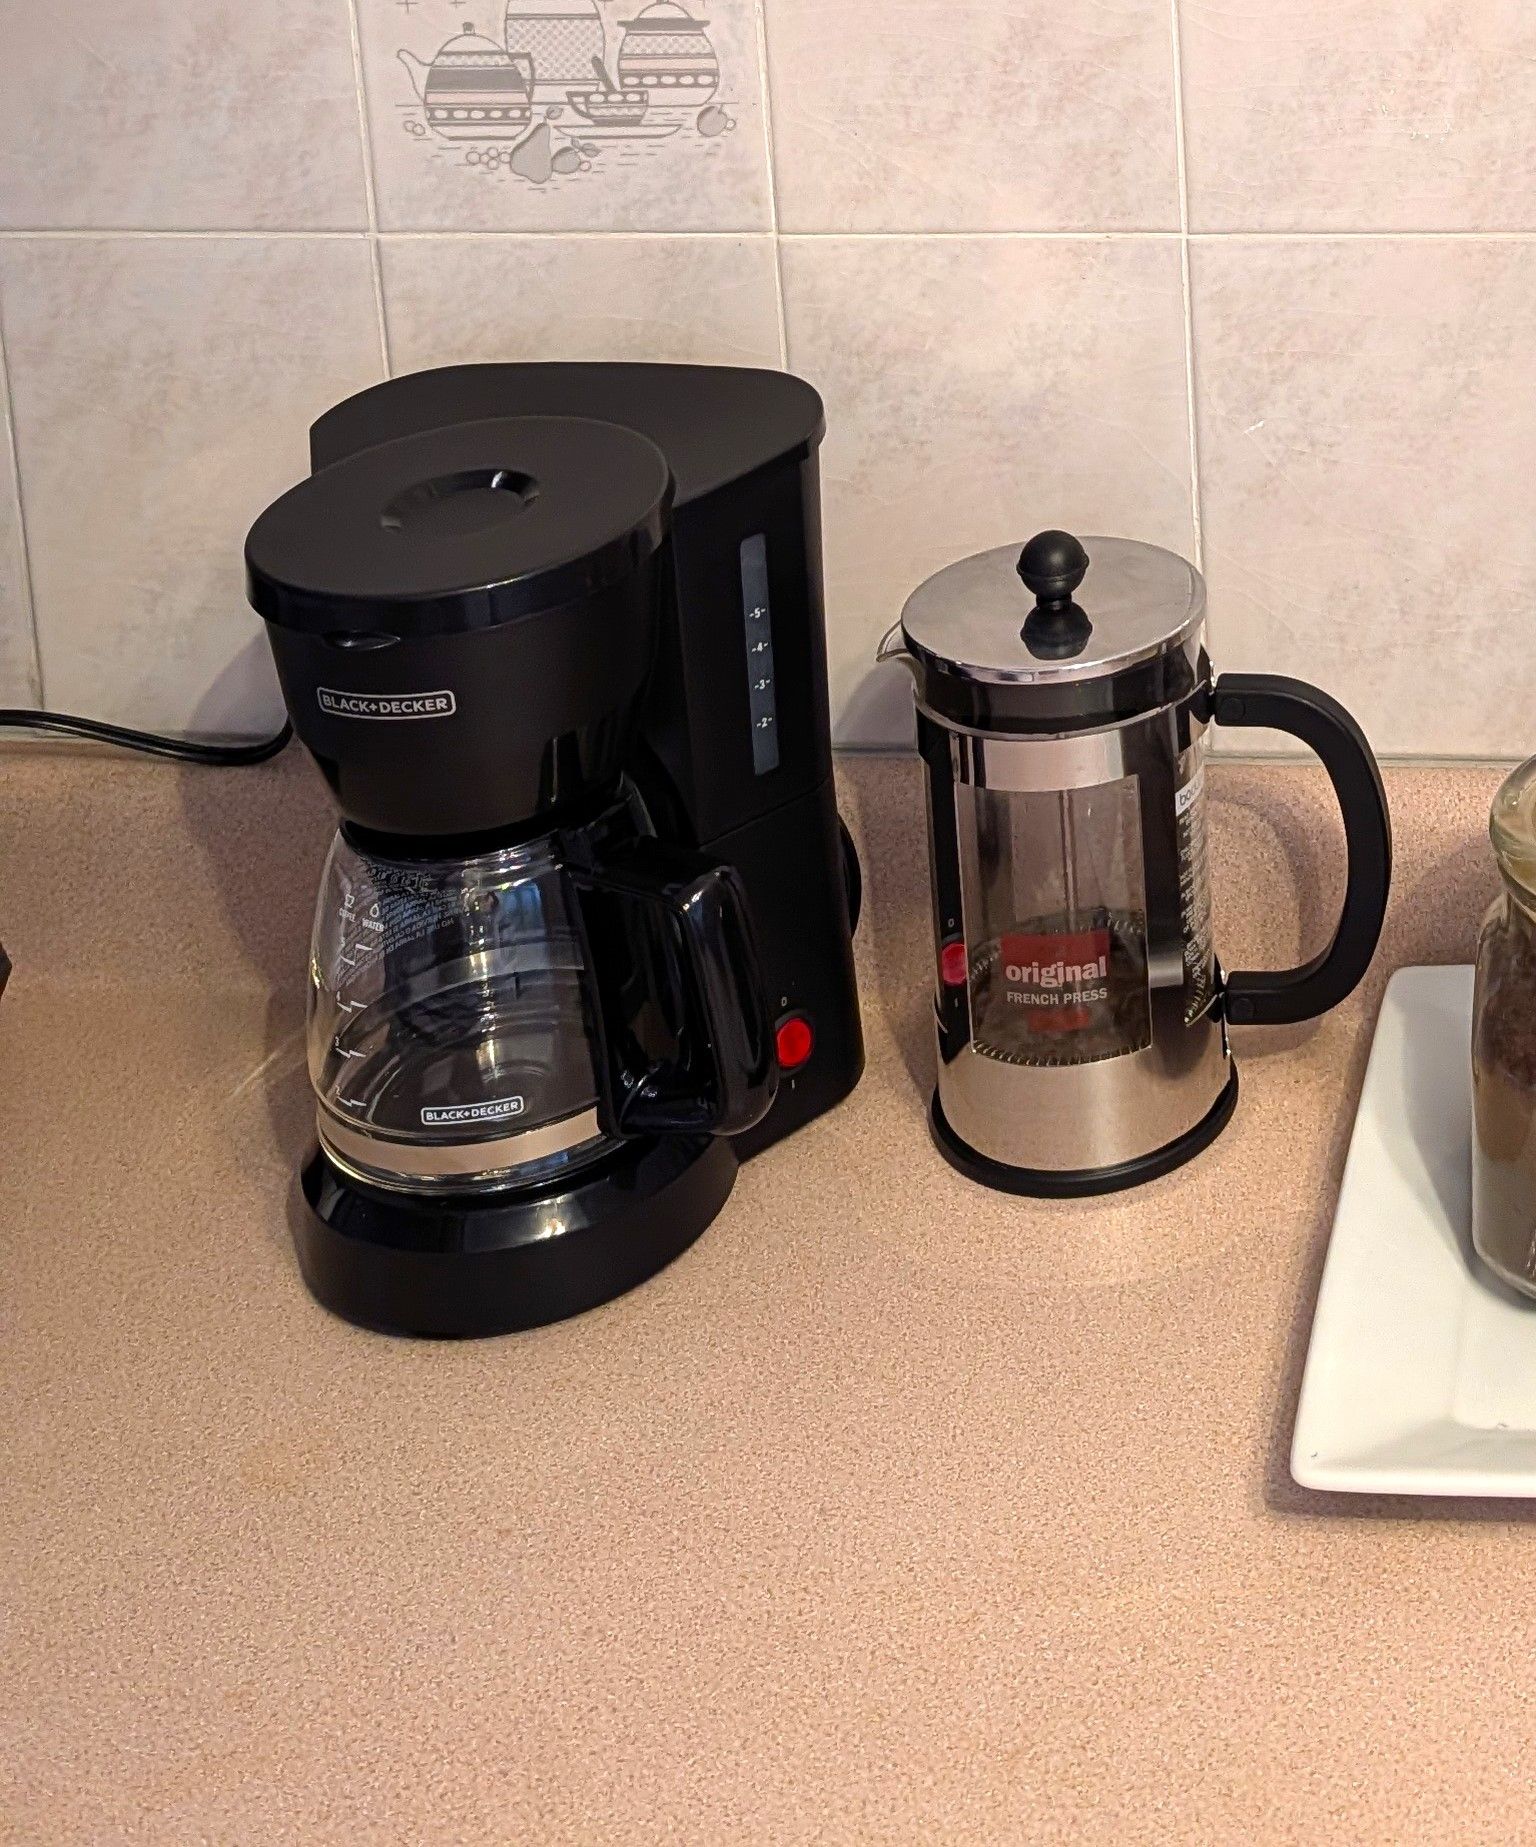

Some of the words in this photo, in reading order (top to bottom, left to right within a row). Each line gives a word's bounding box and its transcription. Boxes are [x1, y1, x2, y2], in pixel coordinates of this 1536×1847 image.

[322, 694, 448, 713] BLACK+DECKER
[1005, 956, 1107, 988] original
[1006, 991, 1059, 1005] FRENCH
[1063, 988, 1108, 1004] PRESS
[425, 1101, 519, 1121] BLACK+DECKER
